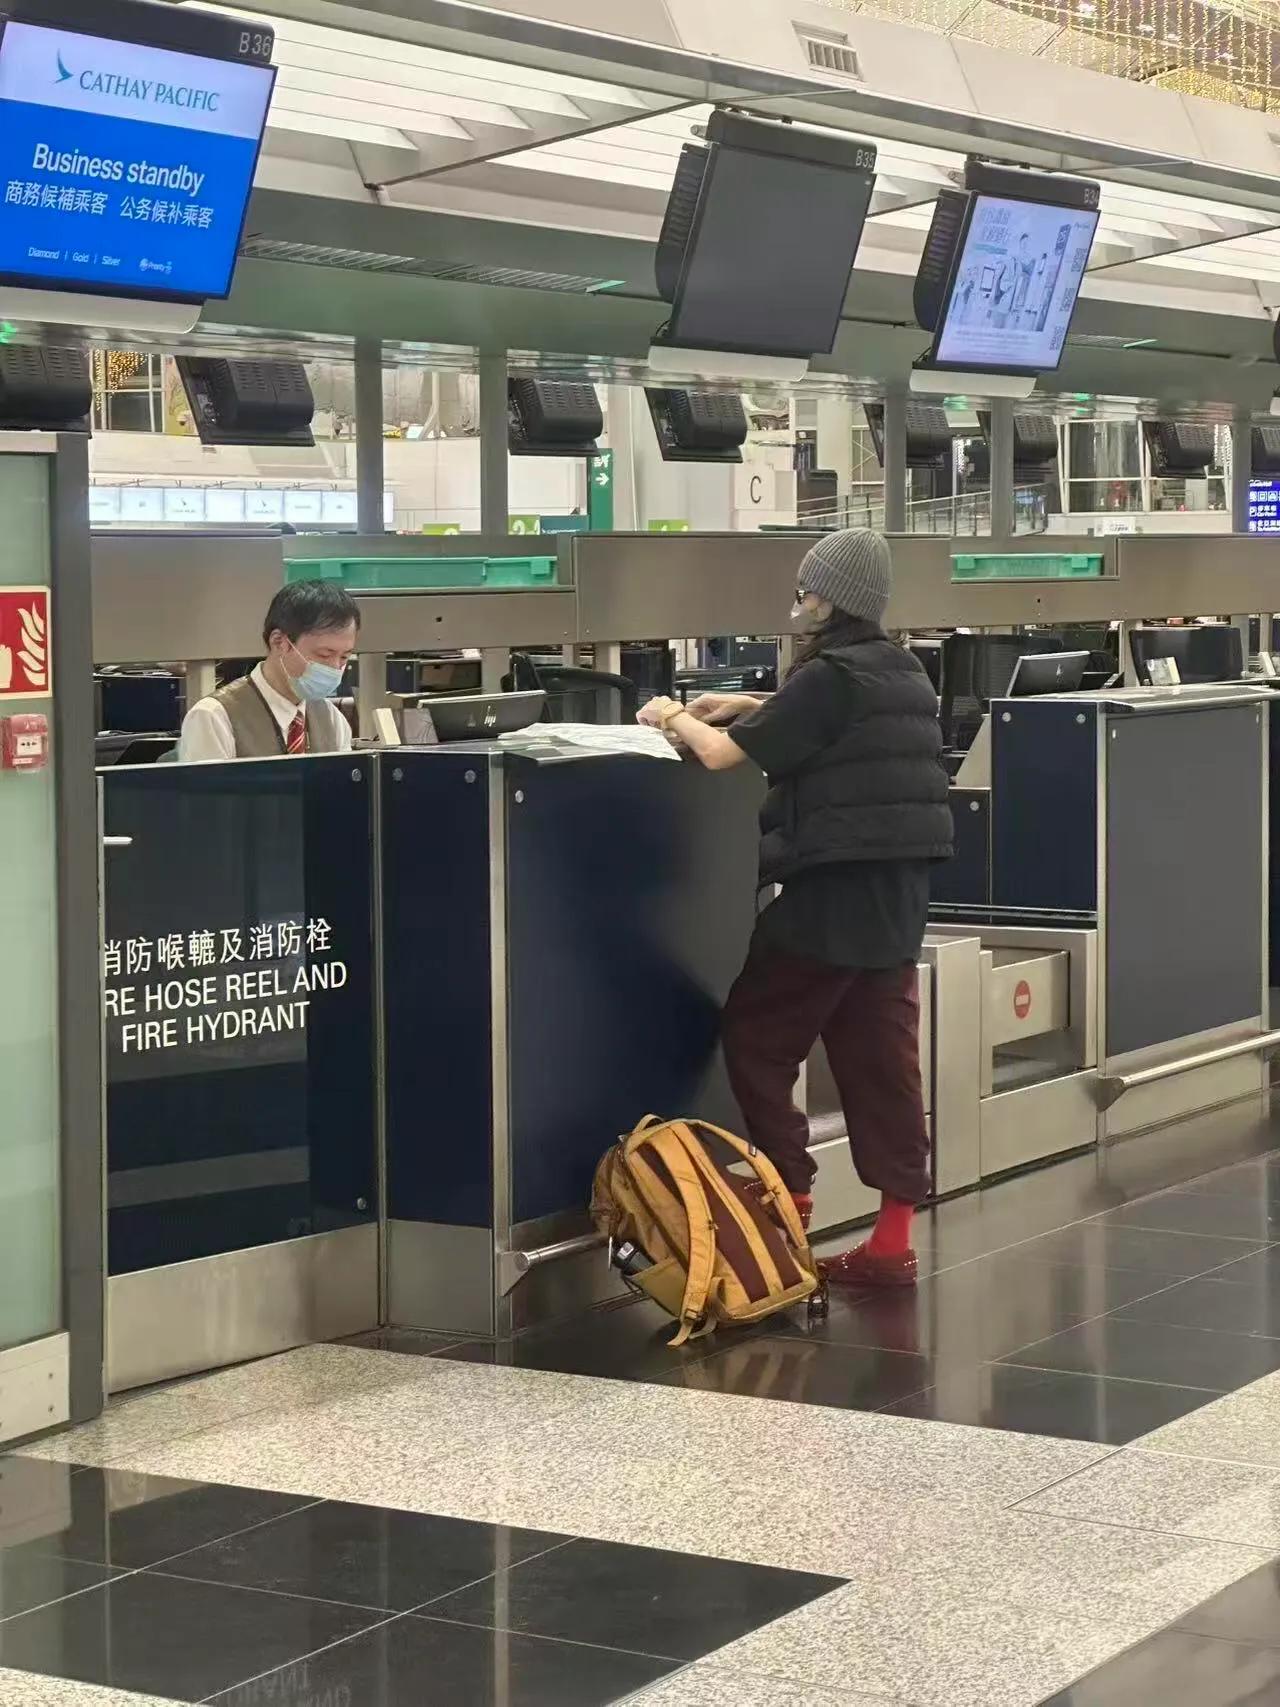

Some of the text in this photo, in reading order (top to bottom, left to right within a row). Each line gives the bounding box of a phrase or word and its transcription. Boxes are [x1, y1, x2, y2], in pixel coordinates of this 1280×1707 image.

[239, 32, 272, 57] B36
[79, 70, 221, 112] CATHAY PACIFIC
[32, 143, 205, 197] Business standby
[855, 149, 876, 168] B35
[5, 180, 214, 229] 商務候補乘客 公务候补乘客
[28, 247, 60, 260] Diamond
[72, 252, 90, 263] Gold
[750, 475, 762, 504] C
[104, 961, 347, 1017] RE HOSE REEL AND
[121, 1001, 310, 1053] FIRE HYDRANT
